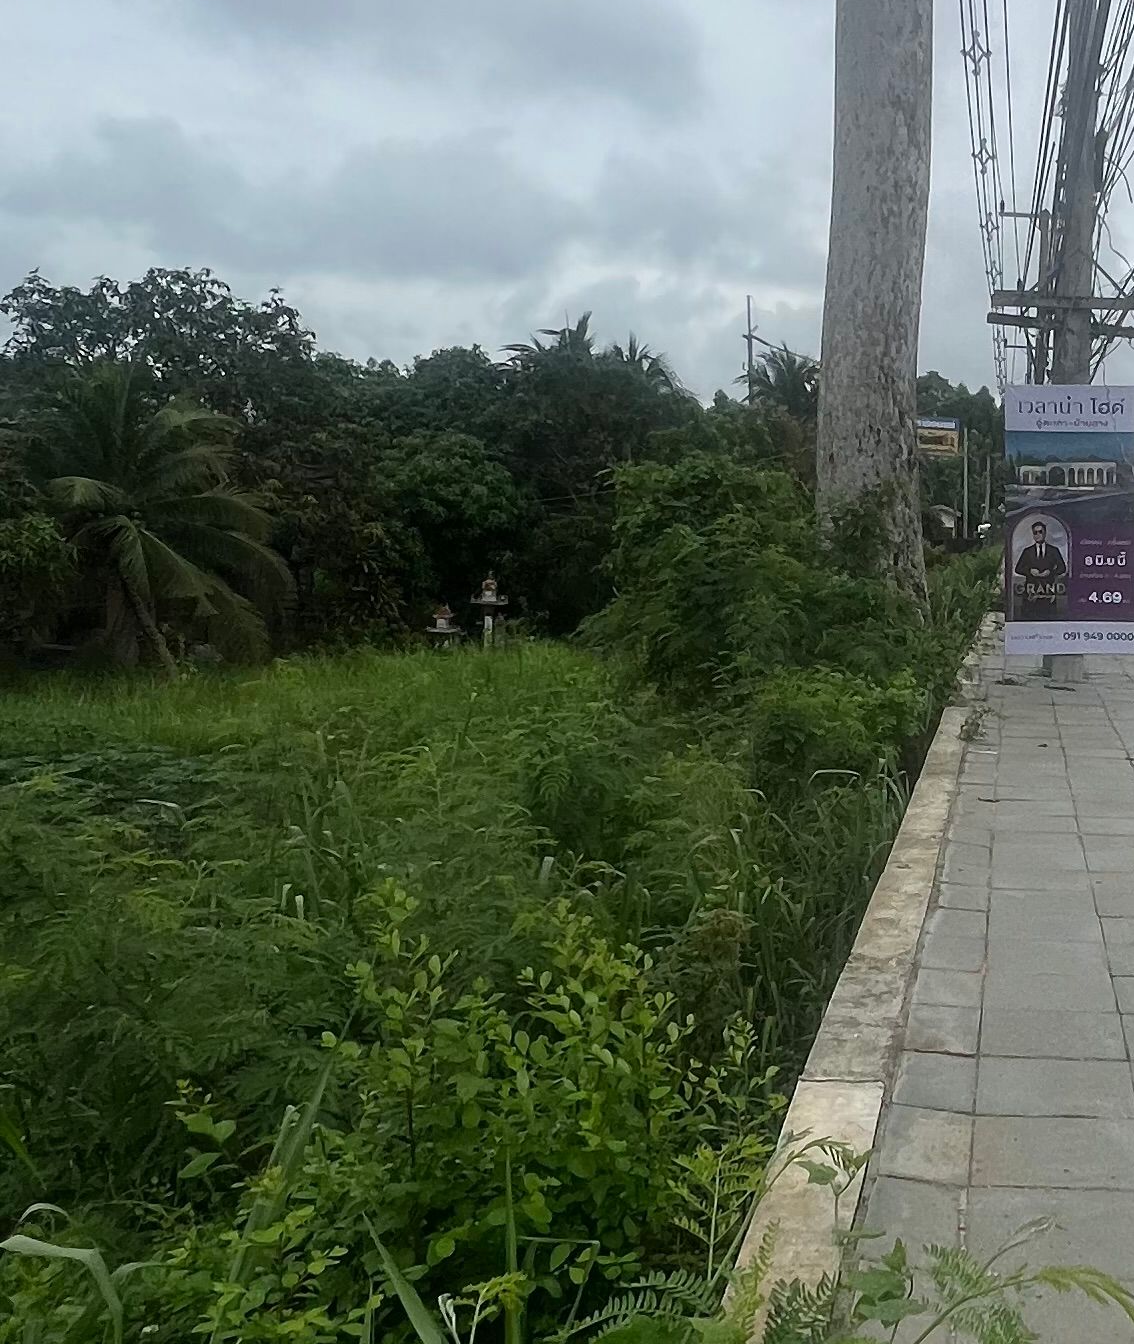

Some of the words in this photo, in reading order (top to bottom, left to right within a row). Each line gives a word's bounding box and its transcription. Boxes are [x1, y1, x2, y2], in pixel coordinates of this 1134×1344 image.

[1015, 582, 1066, 594] GRAND
[1088, 591, 1122, 604] 4.69
[1063, 632, 1081, 641] 091
